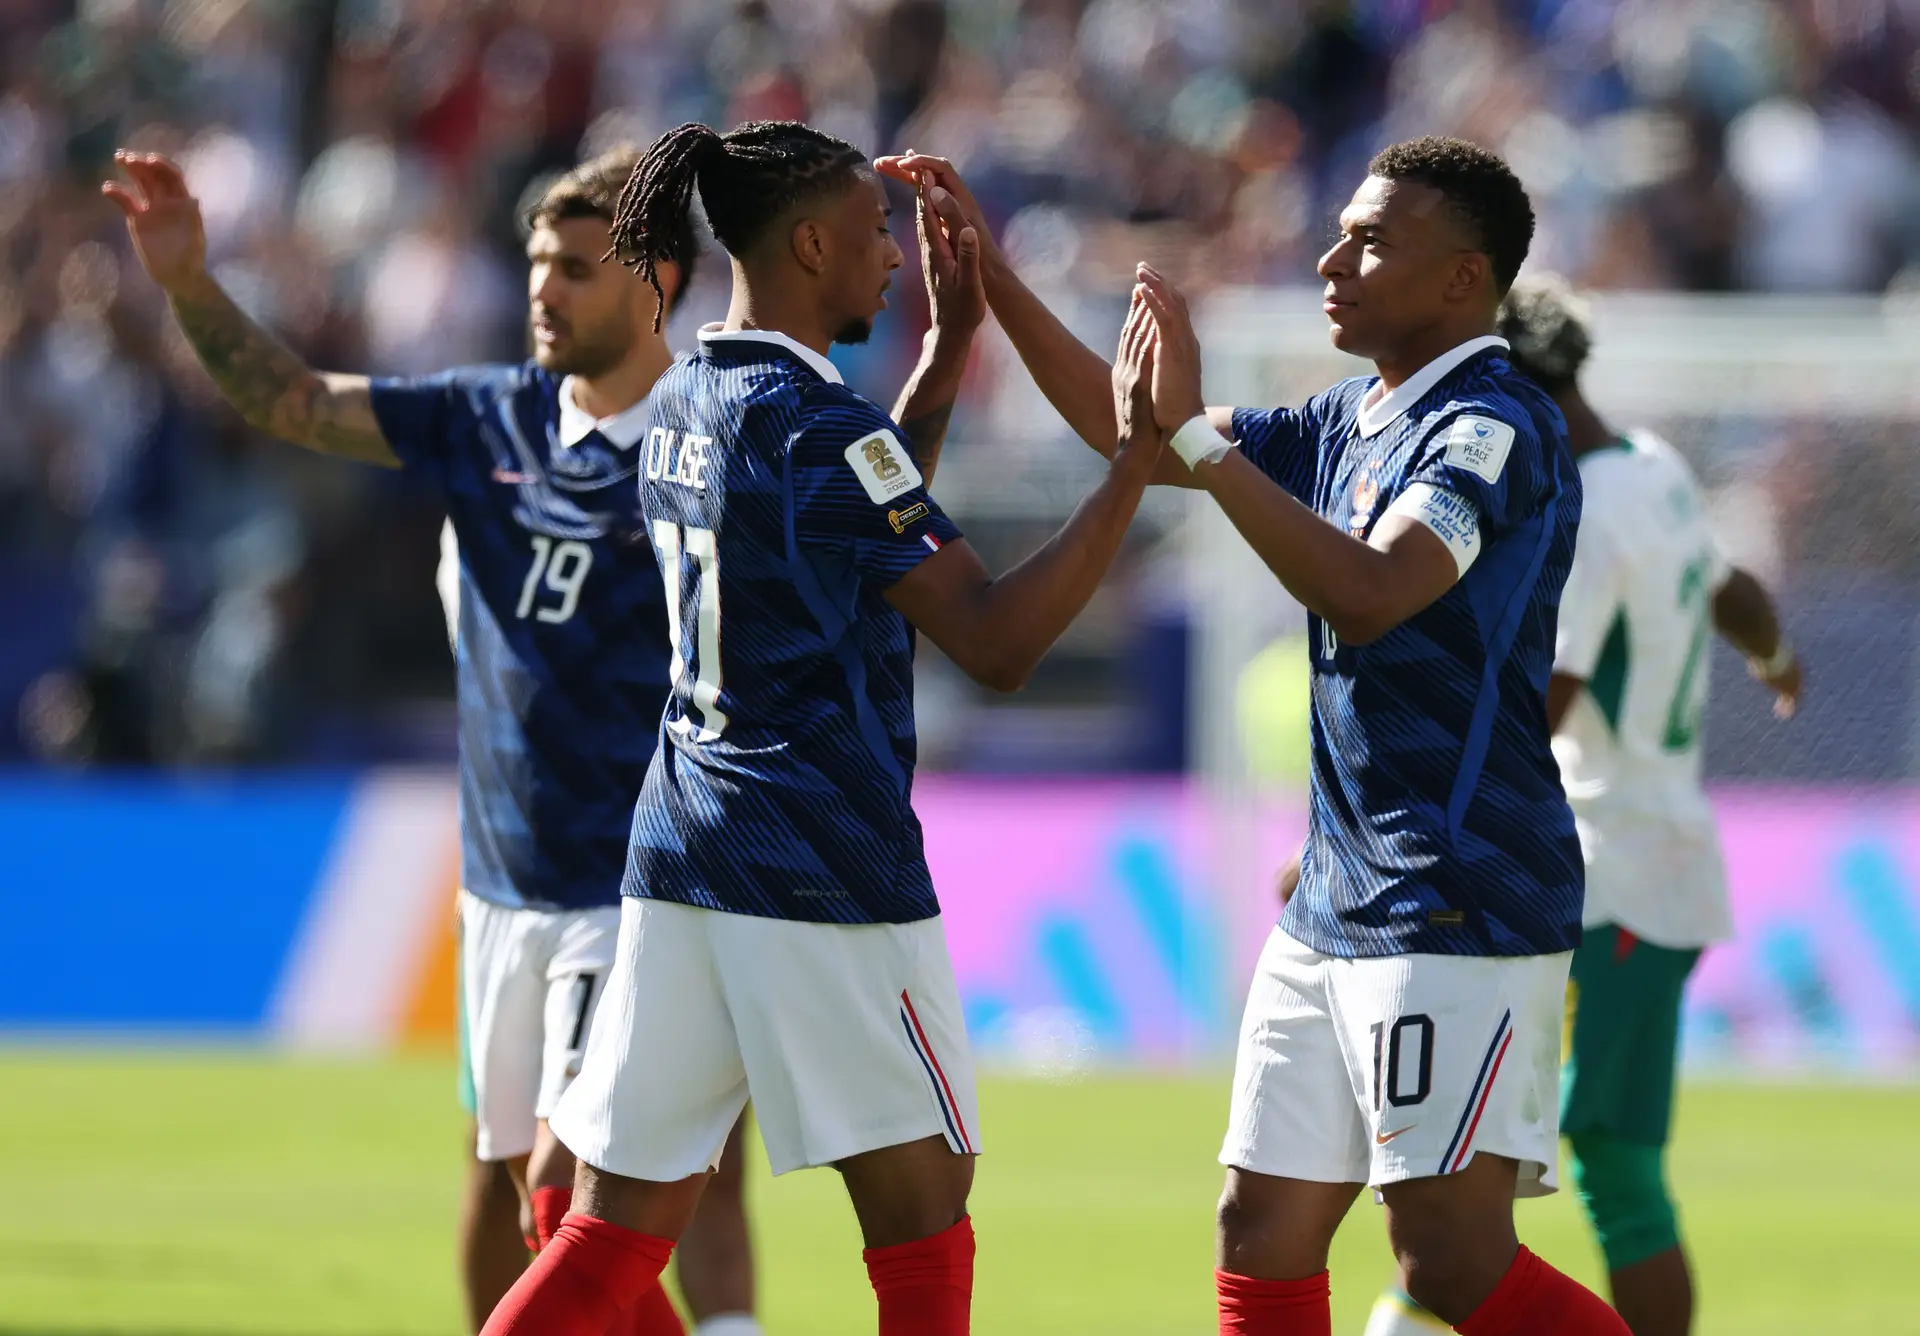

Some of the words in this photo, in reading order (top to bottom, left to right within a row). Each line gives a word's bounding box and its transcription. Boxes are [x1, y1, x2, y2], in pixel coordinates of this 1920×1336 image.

[646, 426, 713, 489] OLISE
[1464, 444, 1489, 464] PEACE
[1465, 456, 1480, 466] FIFA
[886, 480, 910, 494] 2026
[899, 506, 922, 522] DEBUT
[1430, 490, 1477, 535] UNITES
[515, 535, 594, 624] 19
[566, 972, 597, 1051] 1
[1369, 1013, 1435, 1112] 10
